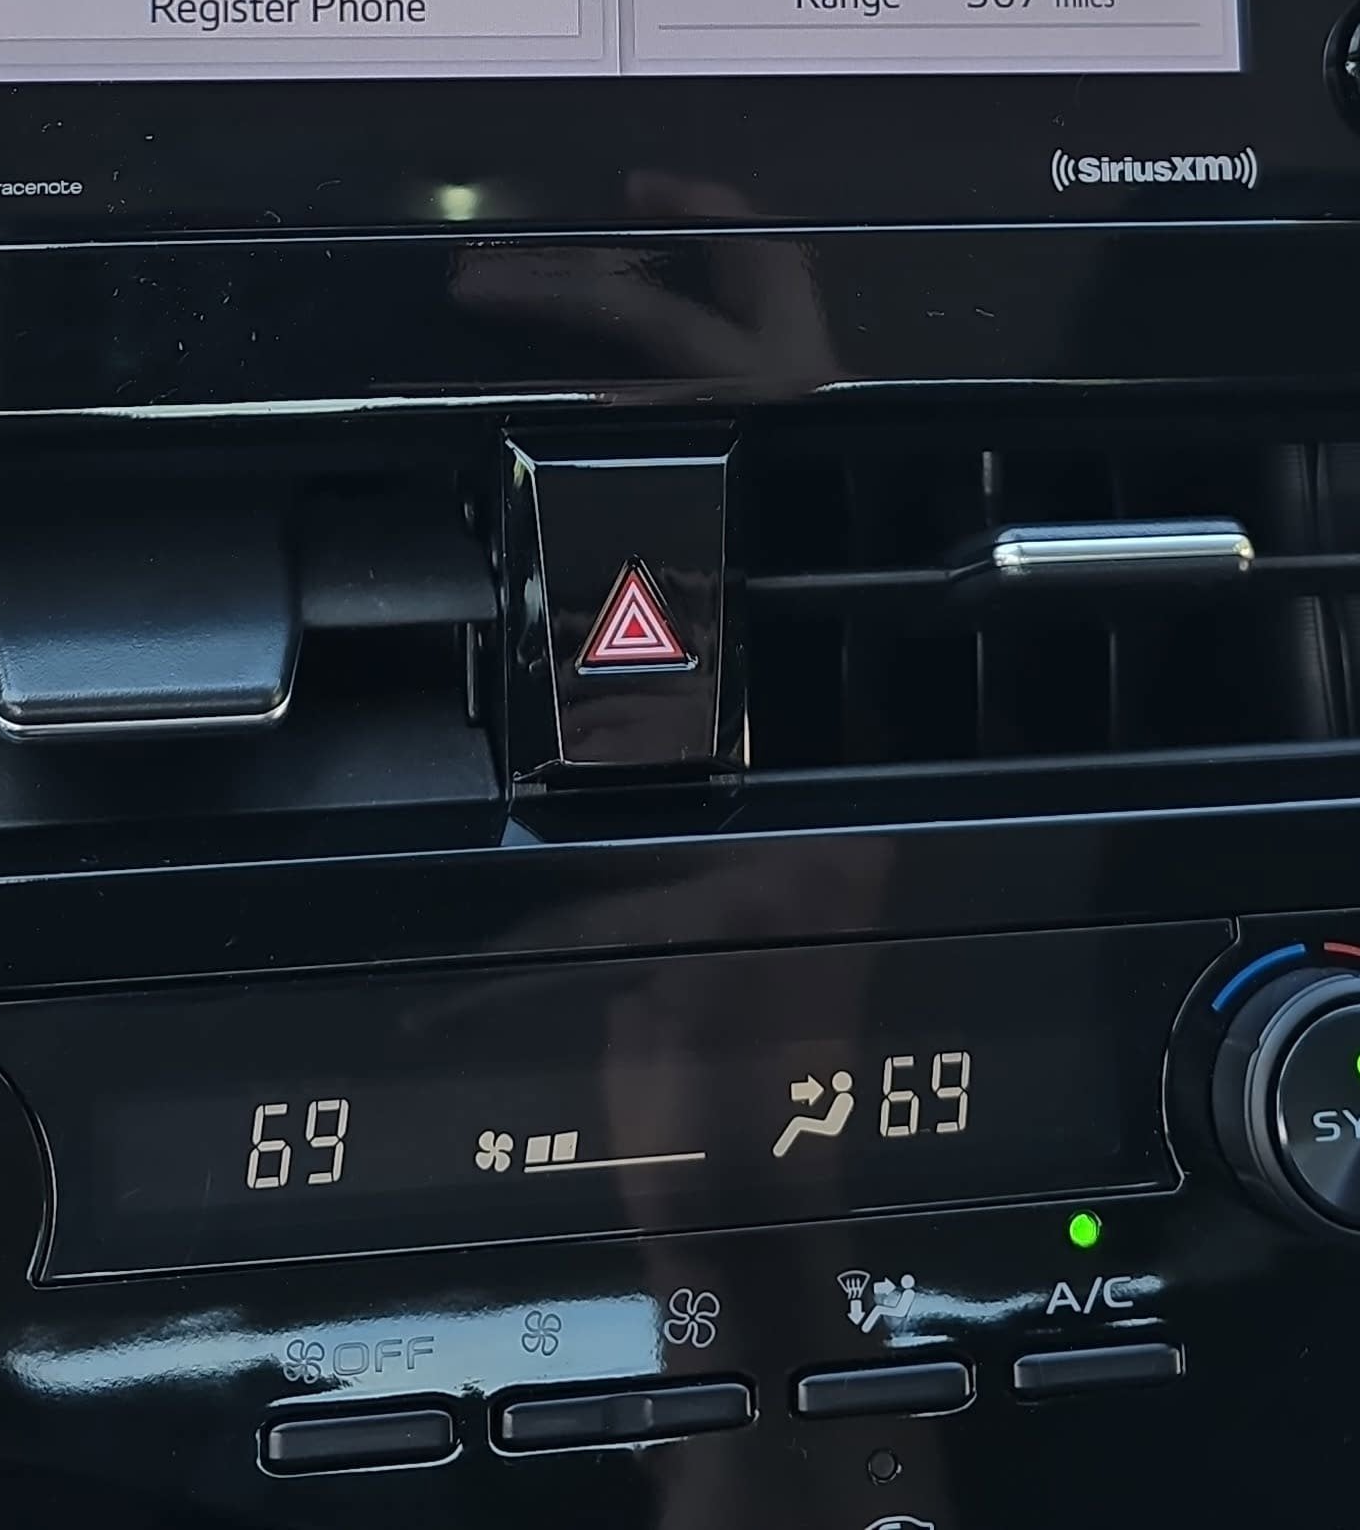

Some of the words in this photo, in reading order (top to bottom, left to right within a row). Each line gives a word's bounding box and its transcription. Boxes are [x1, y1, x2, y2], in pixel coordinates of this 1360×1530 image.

[880, 1050, 971, 1139] 69
[246, 1097, 350, 1189] 69
[1045, 1276, 1134, 1315] A/C
[332, 1335, 435, 1377] OFF
